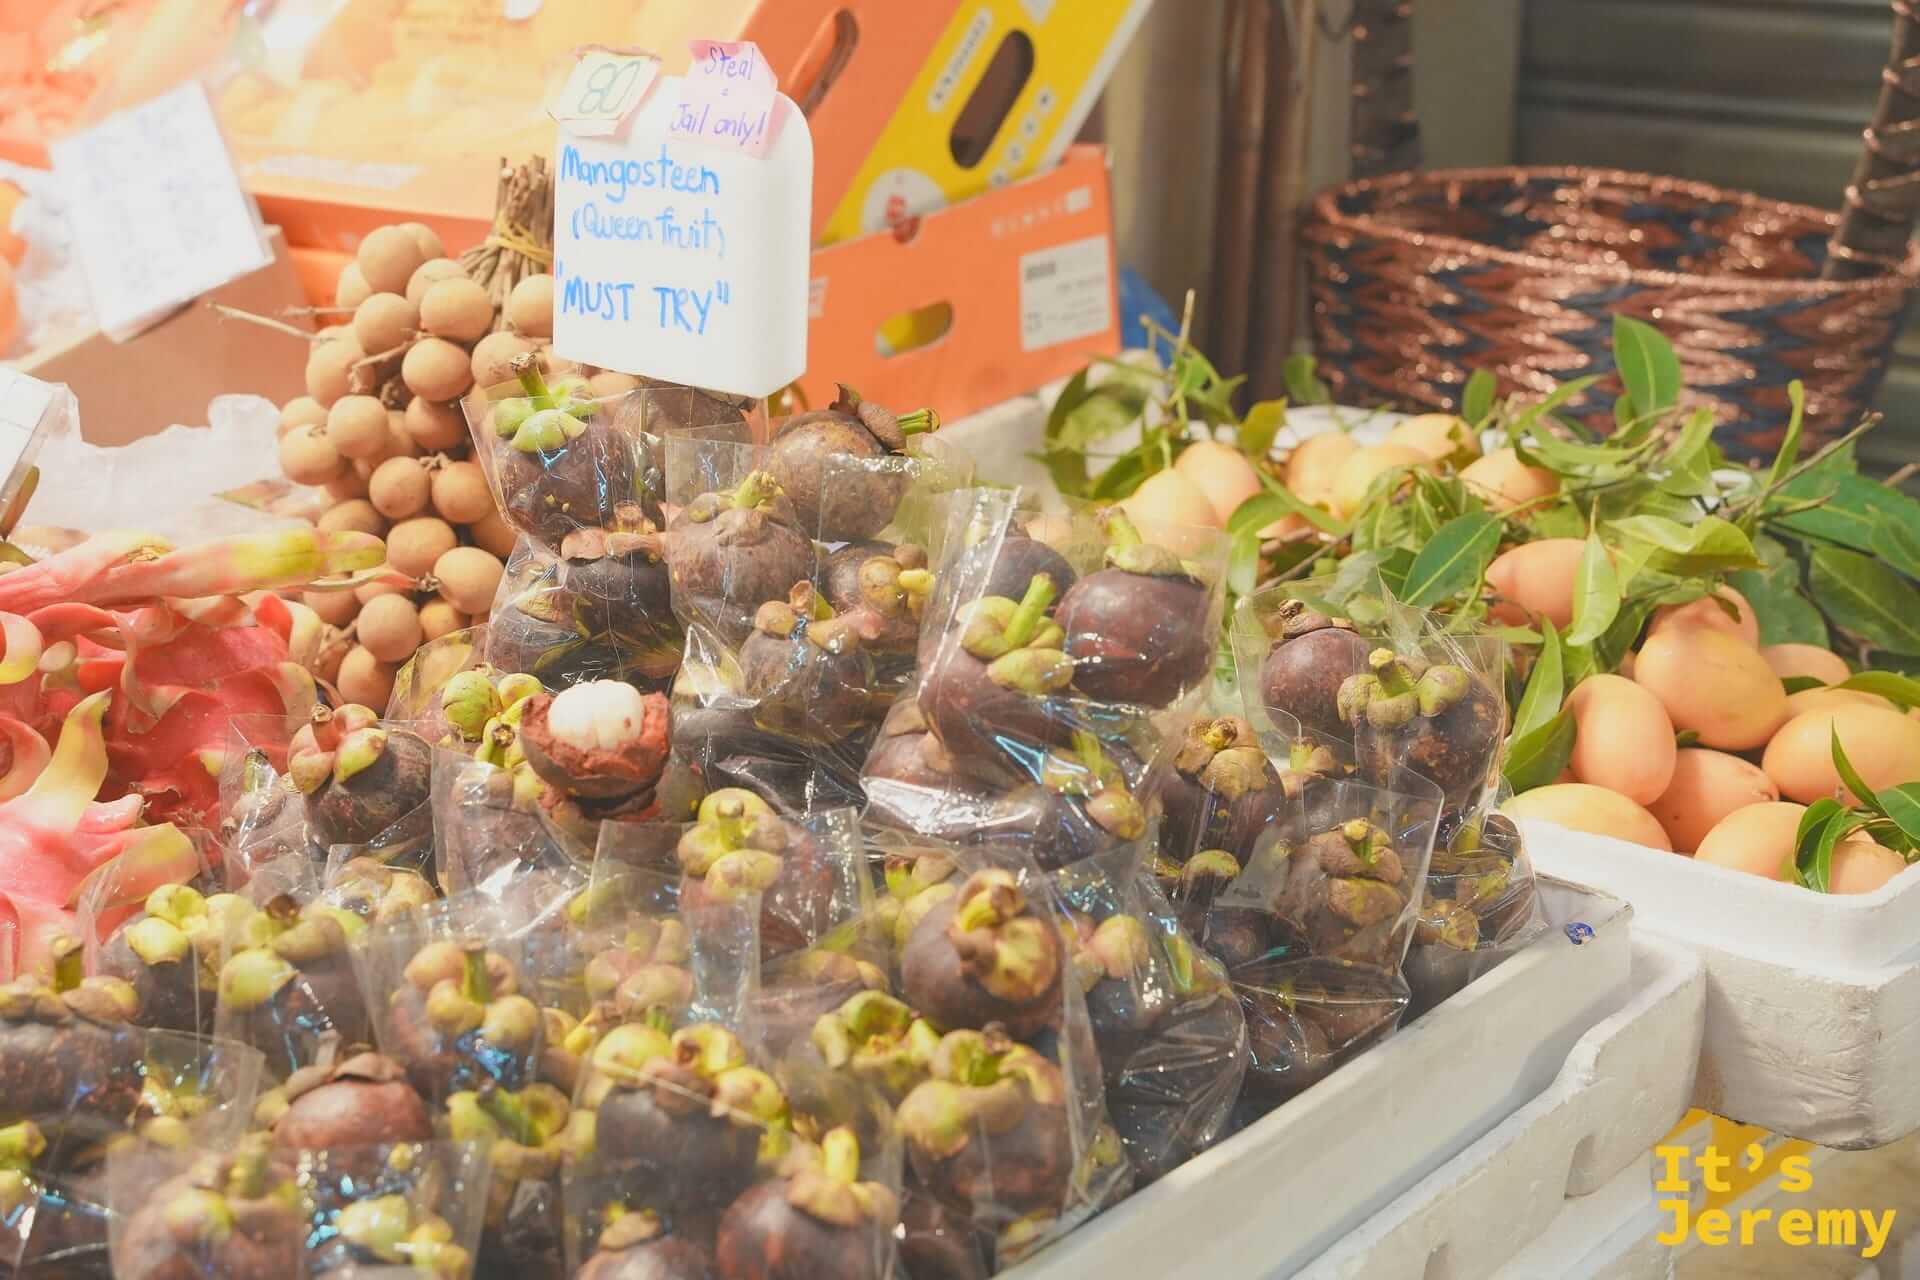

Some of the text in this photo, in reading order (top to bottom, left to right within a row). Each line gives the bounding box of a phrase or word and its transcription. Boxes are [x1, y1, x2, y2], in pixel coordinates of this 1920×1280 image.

[577, 61, 641, 115] 80
[704, 46, 754, 80] Steal
[670, 103, 767, 146] Jail only!
[561, 143, 721, 203] Mangosteen
[572, 202, 726, 257] (Queen fruit)
[556, 260, 730, 335] "MUST TRY"
